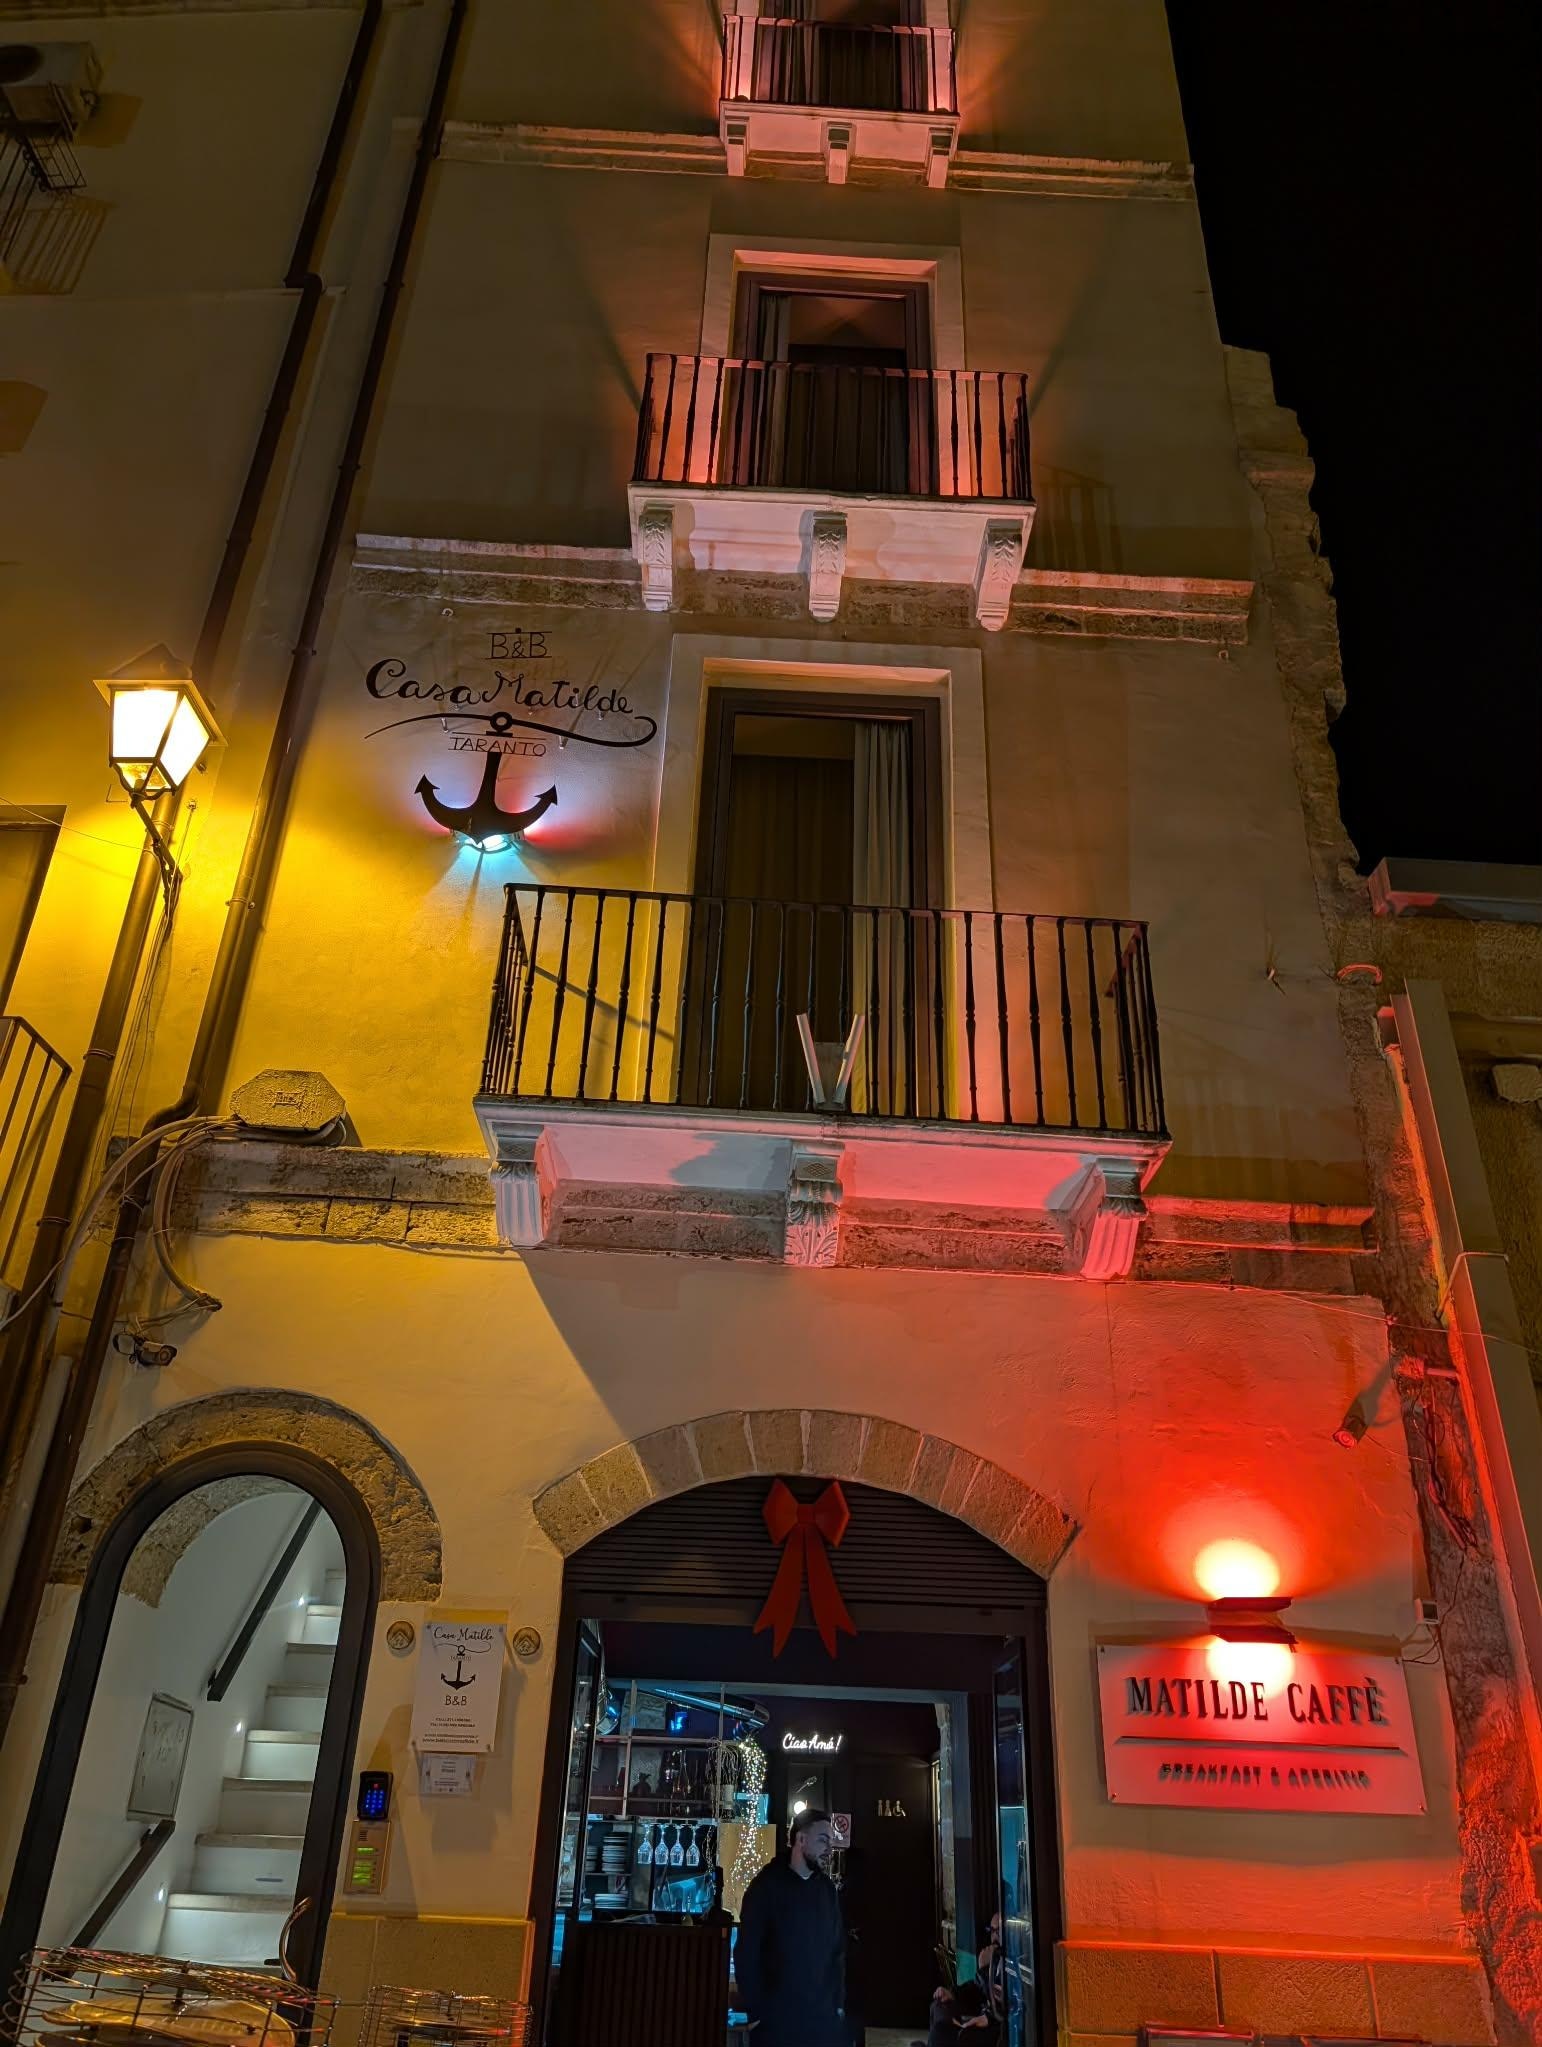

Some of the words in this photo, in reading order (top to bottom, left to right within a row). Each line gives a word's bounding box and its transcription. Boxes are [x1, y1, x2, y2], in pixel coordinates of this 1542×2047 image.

[490, 631, 549, 659] B&B
[365, 658, 482, 705] Casa
[482, 670, 634, 714] Matilde
[450, 736, 547, 757] TARANTO
[434, 1626, 457, 1640] Casa
[445, 1695, 468, 1706] B&B
[1127, 1676, 1269, 1721] MATILDE
[1287, 1676, 1385, 1723] CAFFÈ
[783, 1733, 808, 1749] Ciao
